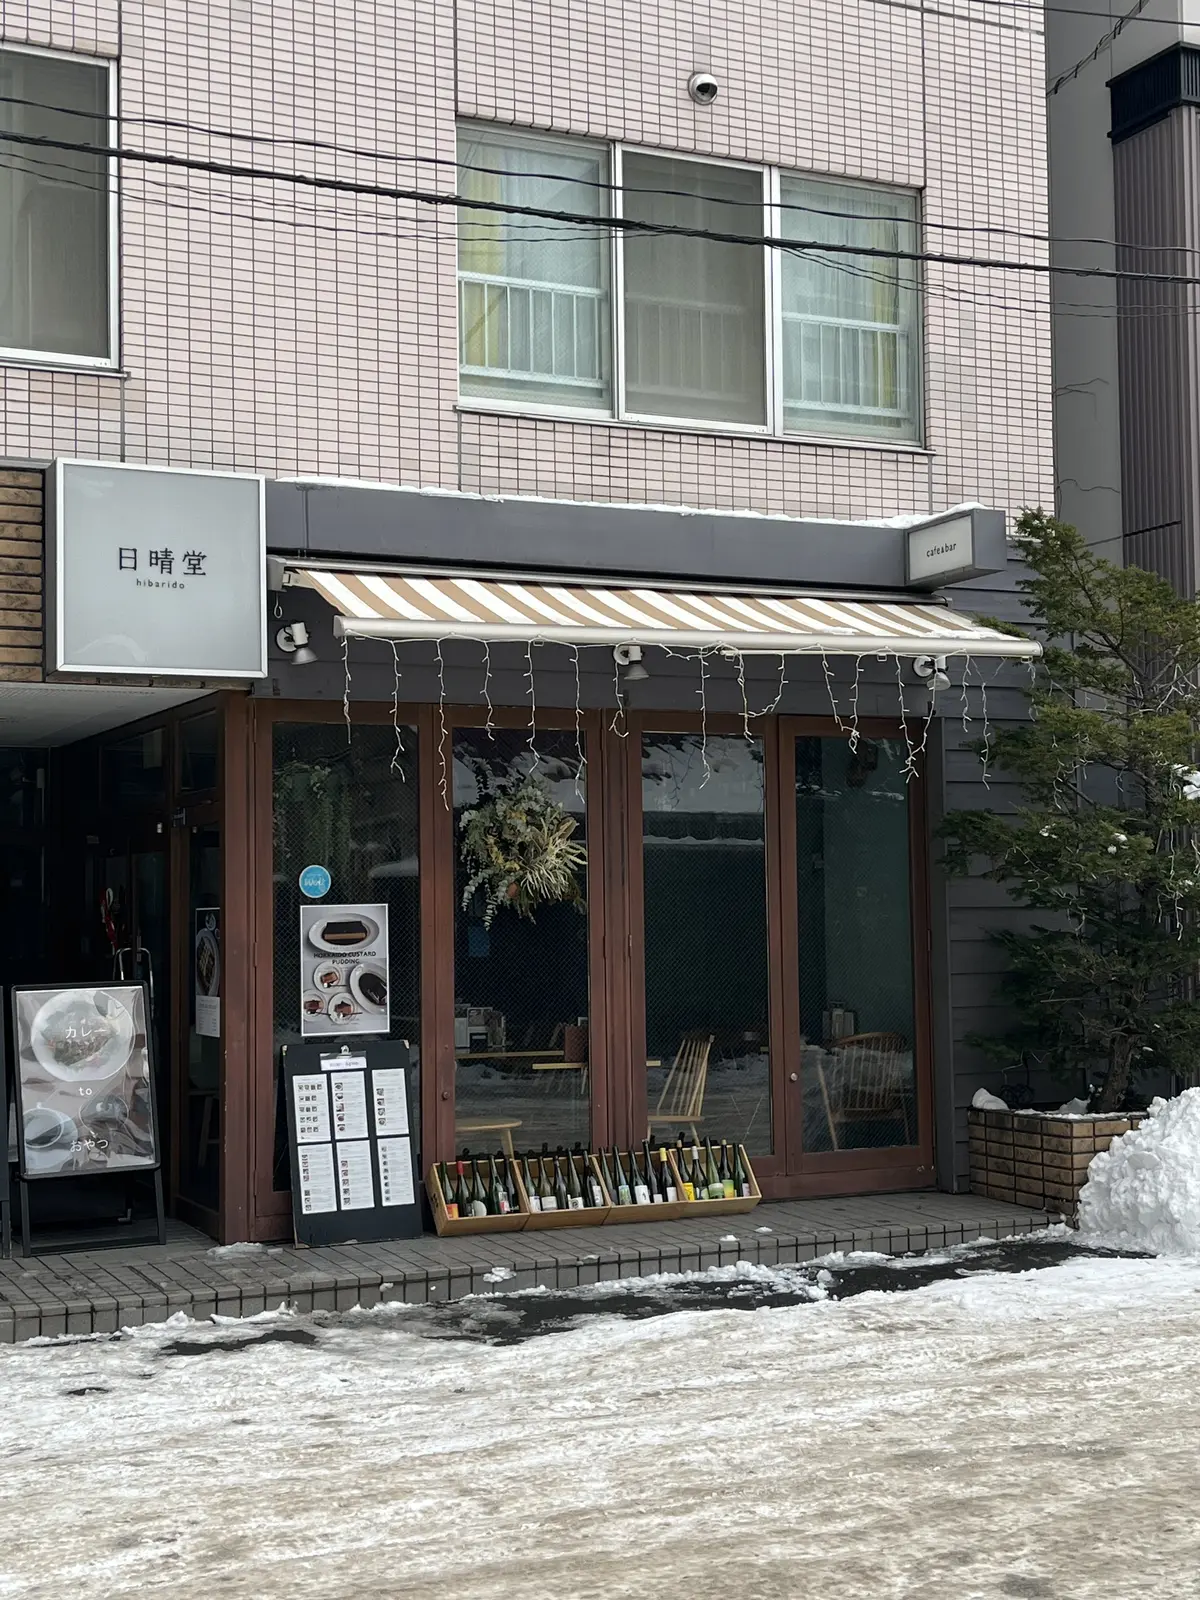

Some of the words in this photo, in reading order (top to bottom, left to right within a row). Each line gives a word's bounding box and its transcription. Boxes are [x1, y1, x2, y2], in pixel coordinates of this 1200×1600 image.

[926, 543, 957, 557] cafe&bar
[118, 547, 207, 576] 日晴堂
[136, 579, 185, 589] hibarido
[64, 1026, 107, 1040] カレー
[78, 1086, 92, 1096] to
[69, 1138, 109, 1154] おやつ
